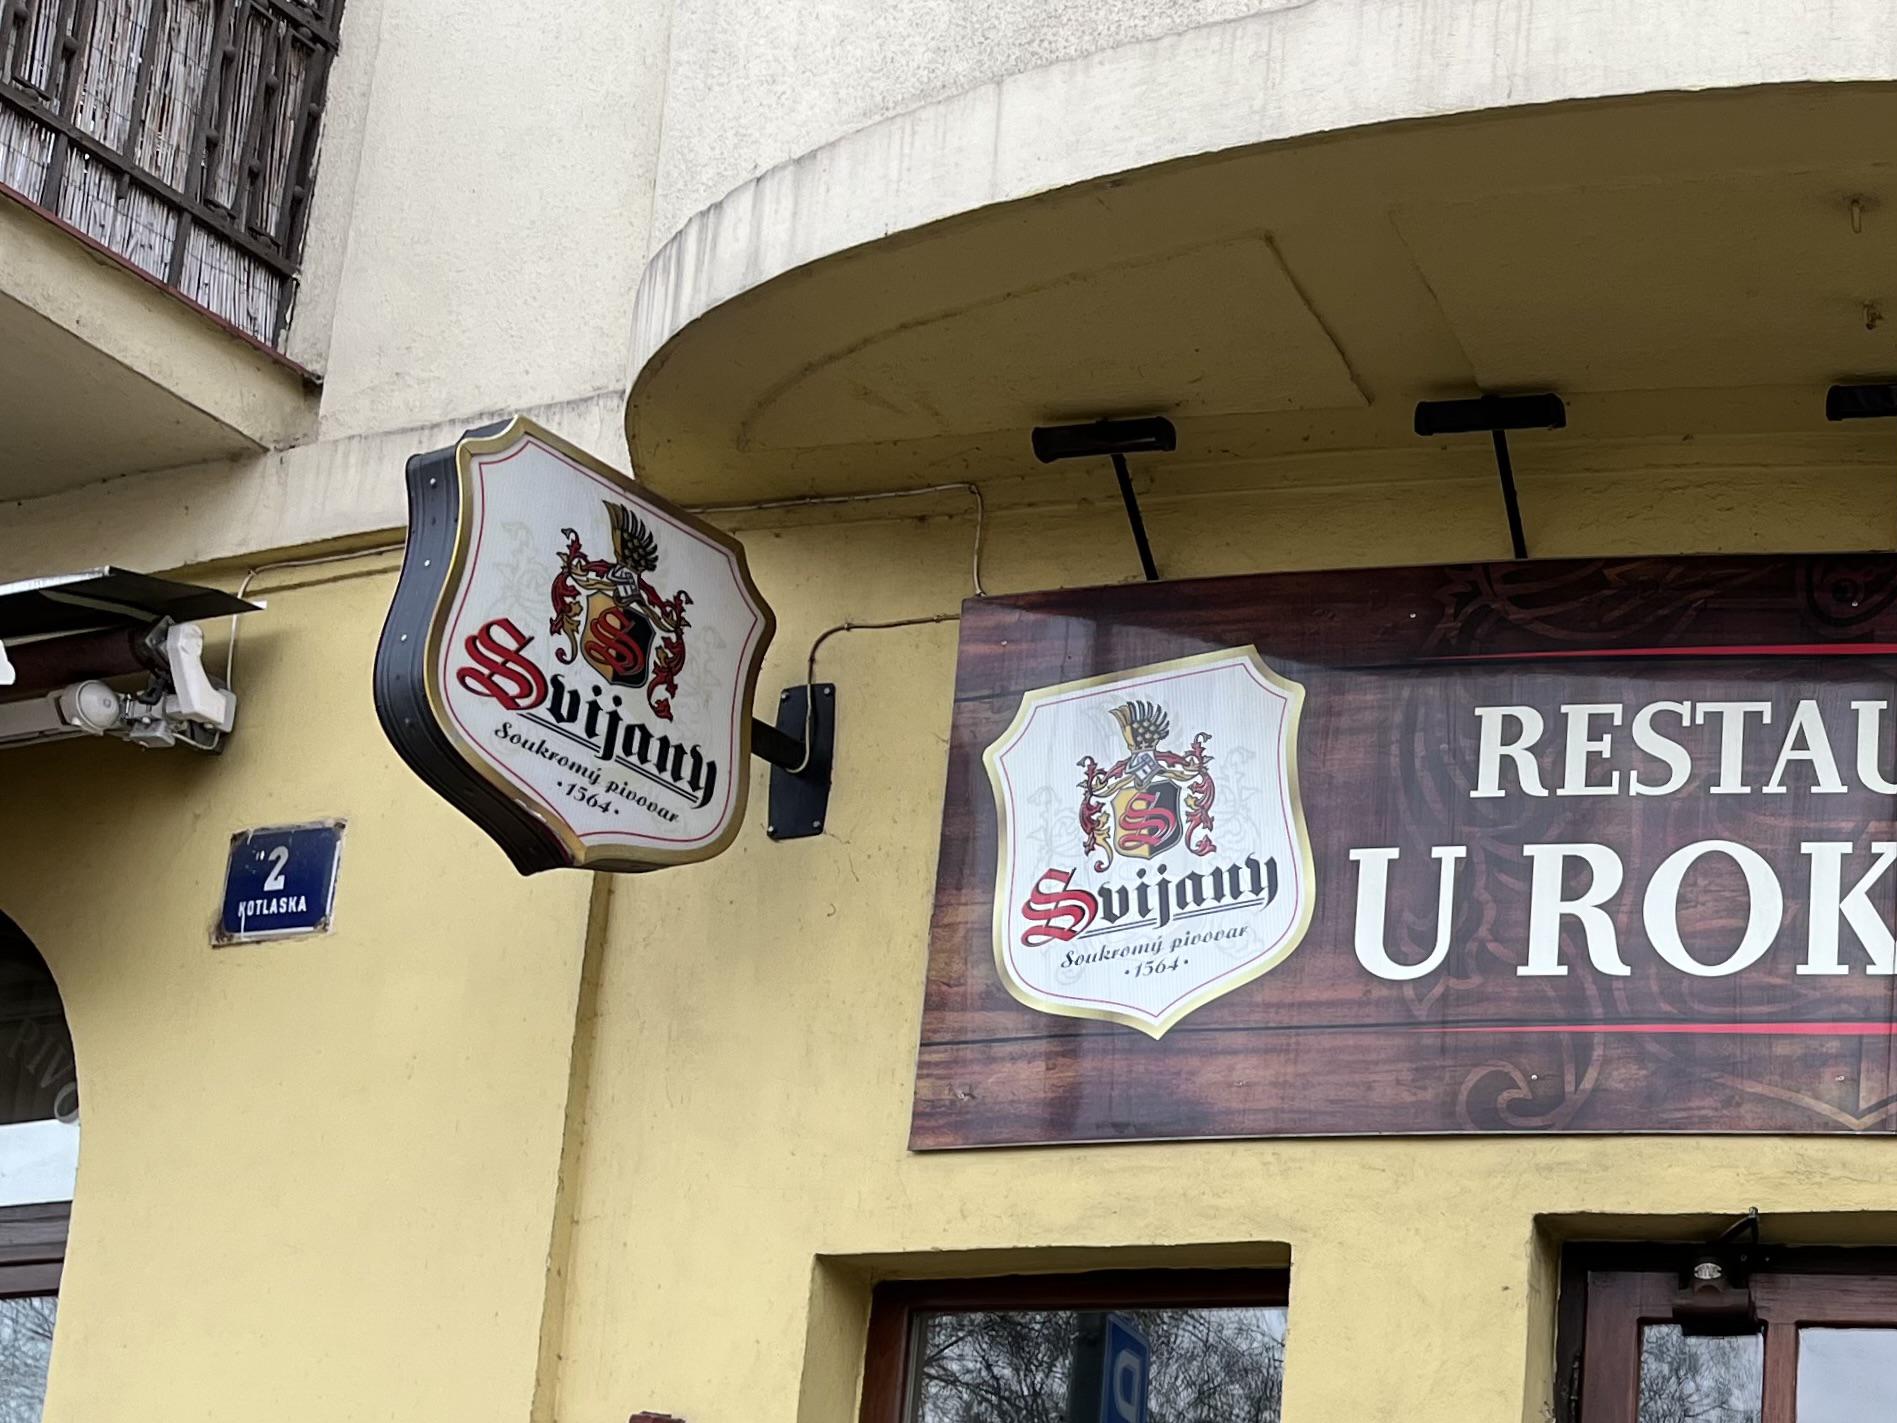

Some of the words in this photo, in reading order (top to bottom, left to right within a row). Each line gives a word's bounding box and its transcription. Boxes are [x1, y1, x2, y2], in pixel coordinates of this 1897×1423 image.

[456, 617, 718, 809] Svijany
[494, 721, 602, 785] Soukromý
[604, 776, 681, 824] pivovar
[237, 896, 307, 918] KOTLASKA
[263, 845, 289, 892] 2
[1020, 852, 1279, 947] Svijany
[1348, 845, 1467, 982] U
[1060, 935, 1162, 970] Soukromý
[1169, 924, 1249, 954] pivovar
